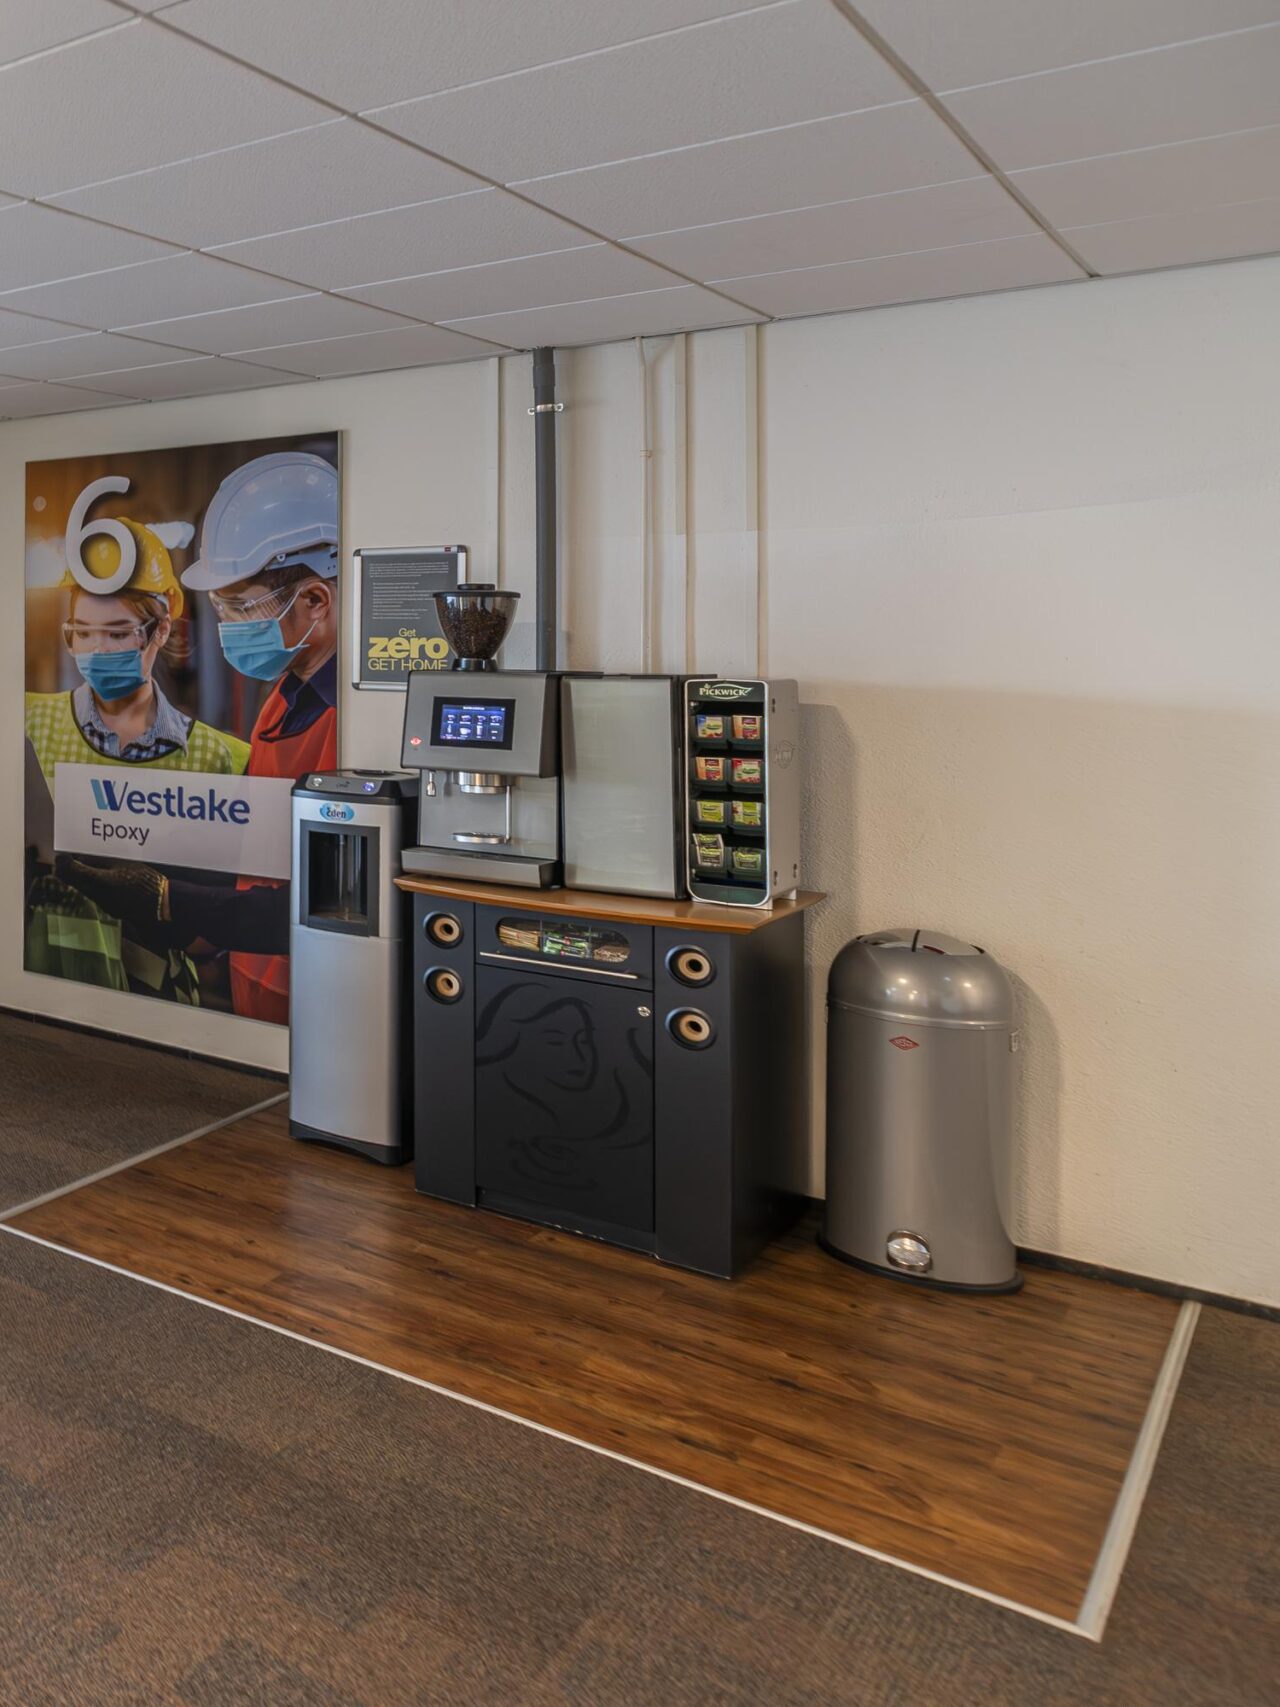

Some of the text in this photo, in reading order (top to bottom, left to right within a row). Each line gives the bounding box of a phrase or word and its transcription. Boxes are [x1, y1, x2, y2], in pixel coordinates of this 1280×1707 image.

[65, 476, 136, 594] 6
[398, 628, 416, 637] Get
[368, 636, 449, 659] zero
[368, 658, 398, 671] GET
[90, 779, 251, 825] Westlake
[91, 818, 150, 846] Epoxy
